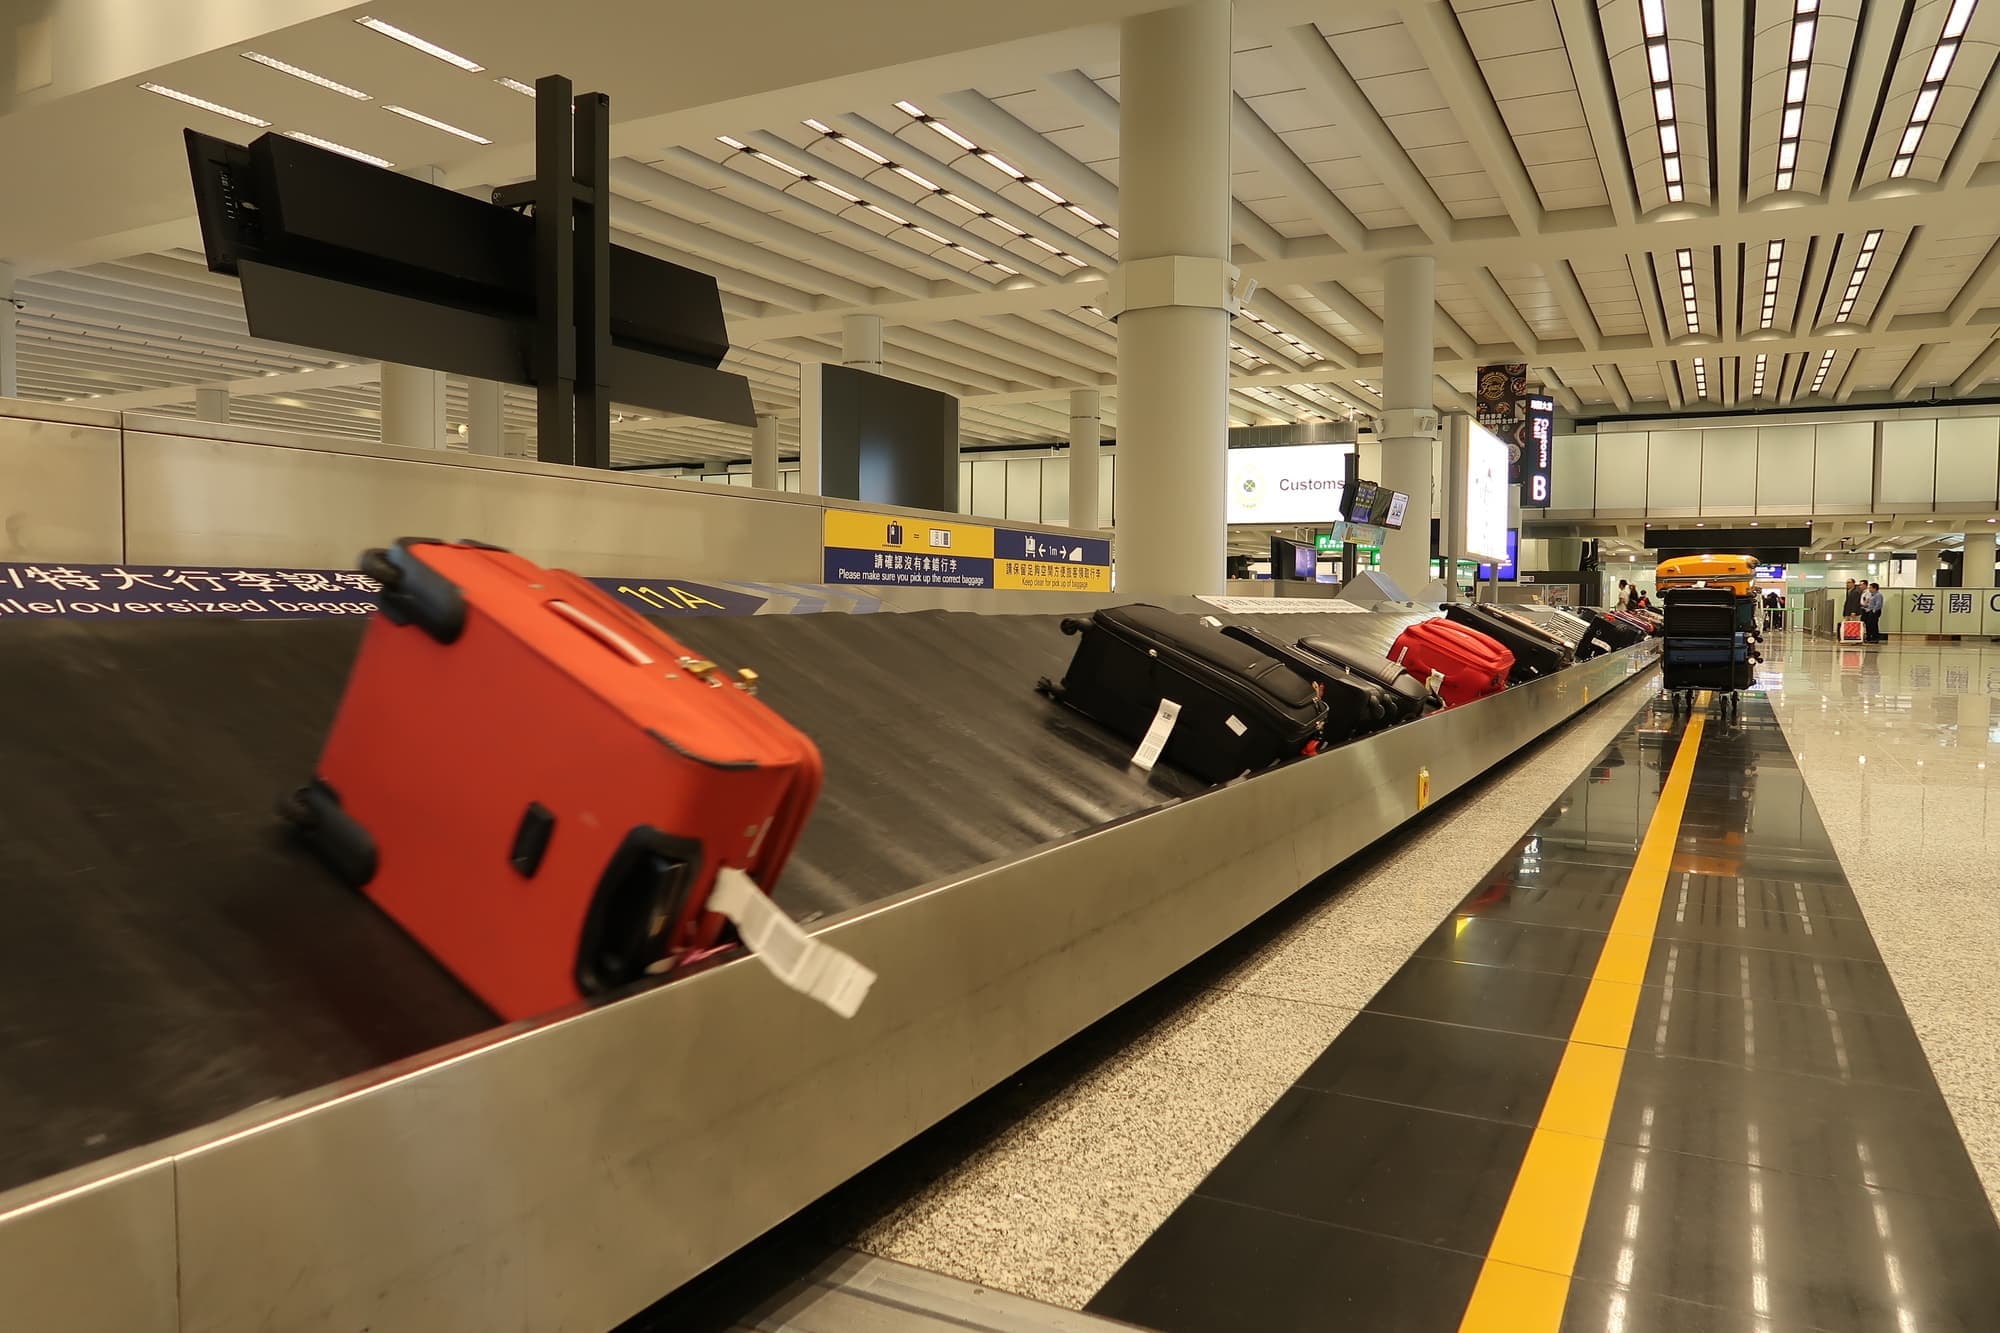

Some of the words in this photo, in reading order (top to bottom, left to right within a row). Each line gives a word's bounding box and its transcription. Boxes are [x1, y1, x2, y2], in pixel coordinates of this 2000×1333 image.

[1280, 478, 1345, 491] Customs
[1533, 475, 1546, 500] B
[1049, 545, 1058, 556] 1m
[0, 567, 384, 592] /特大行李認領
[838, 568, 861, 580] Please
[862, 570, 881, 581] make
[881, 572, 896, 581] sure
[897, 573, 909, 584] you
[909, 571, 922, 583] pick
[922, 575, 931, 584] up
[932, 574, 941, 583] the
[942, 574, 961, 584] correct
[961, 574, 985, 587] baggage
[1022, 577, 1033, 587] Keep
[0, 599, 269, 616] ile/oversized
[269, 599, 380, 615] bagga
[617, 586, 726, 610] 11A
[1911, 593, 1973, 614] 海關
